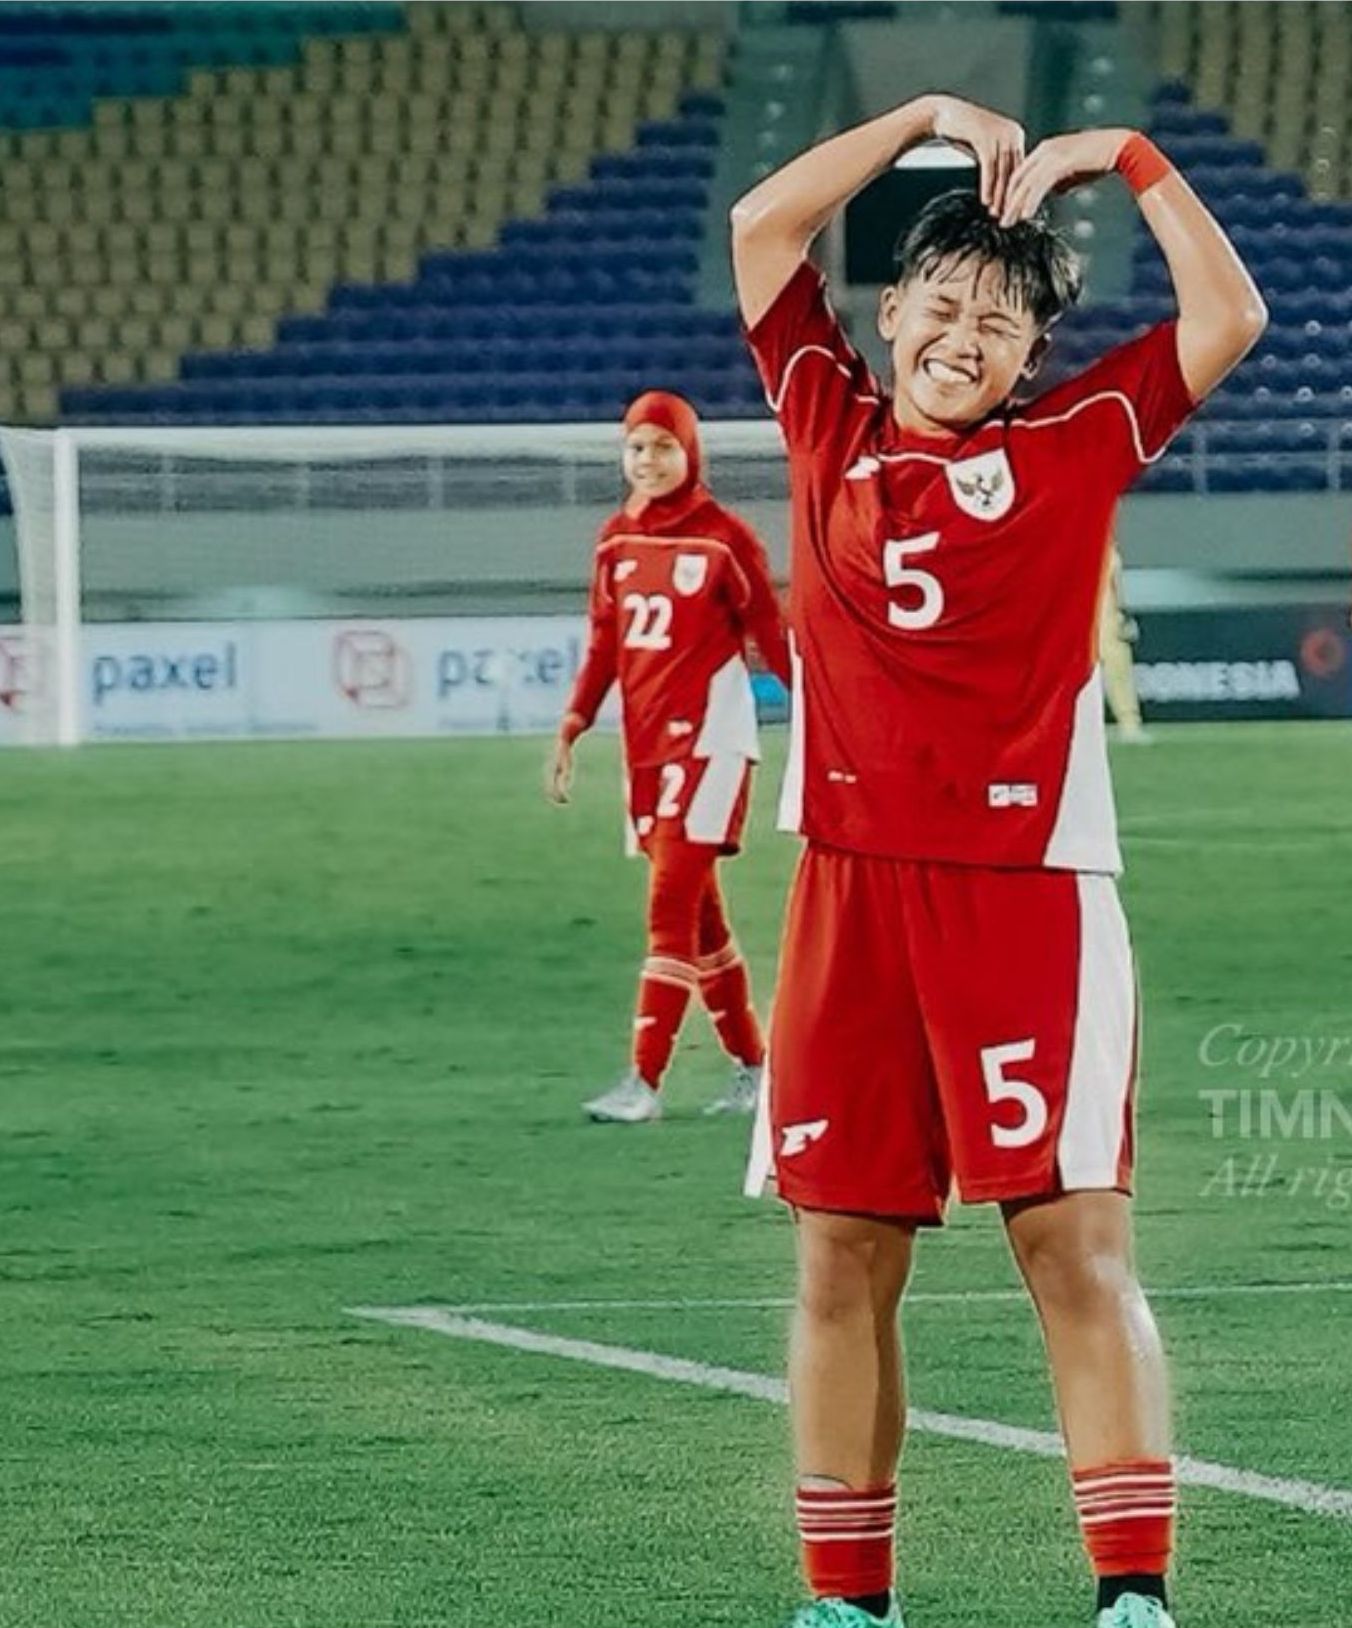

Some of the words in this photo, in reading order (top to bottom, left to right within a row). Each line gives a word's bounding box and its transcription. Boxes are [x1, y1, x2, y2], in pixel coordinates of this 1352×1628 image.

[623, 593, 674, 650] 22
[882, 530, 945, 631] 5
[92, 640, 238, 708] paxel
[979, 1037, 1049, 1149] 5
